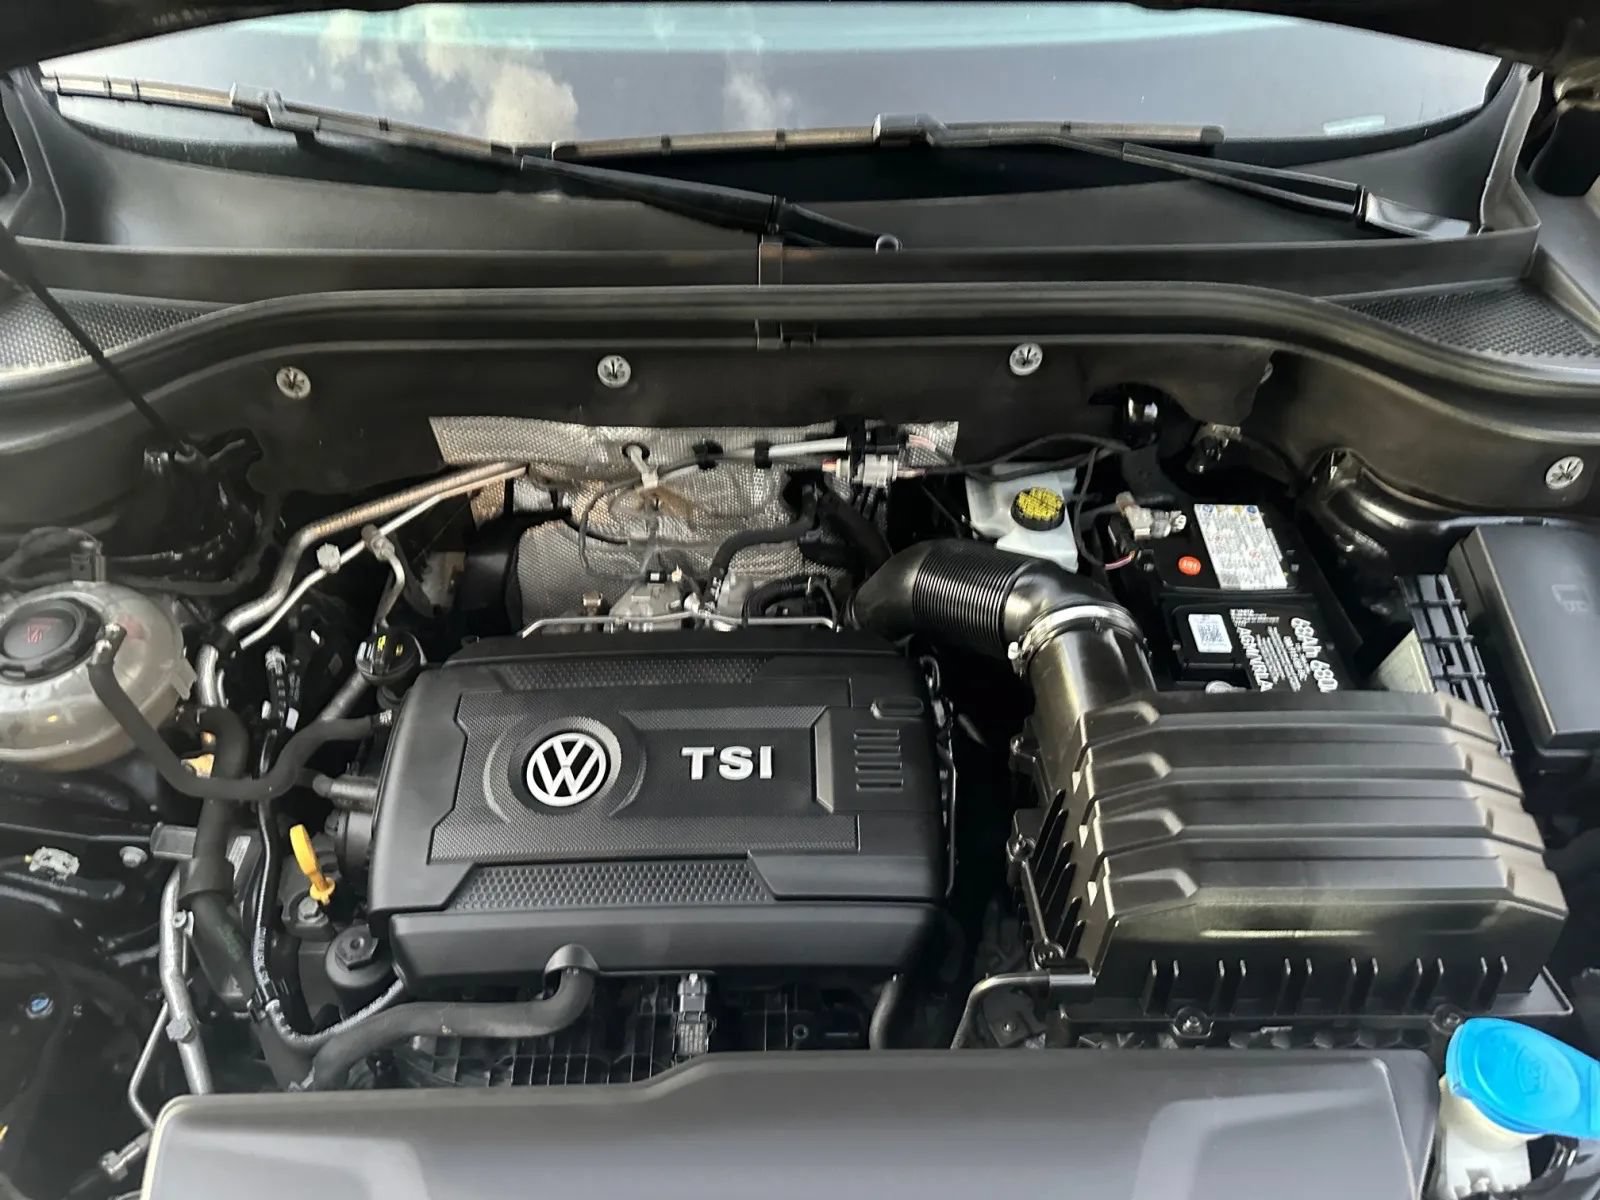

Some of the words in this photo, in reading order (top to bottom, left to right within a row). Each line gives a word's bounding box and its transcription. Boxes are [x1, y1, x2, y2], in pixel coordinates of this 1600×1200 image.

[1236, 626, 1274, 692] AGM/VRLA
[1291, 617, 1321, 658] 68Ah
[1310, 660, 1338, 692] 680
[526, 732, 607, 807] VW
[681, 746, 773, 780] TSI
